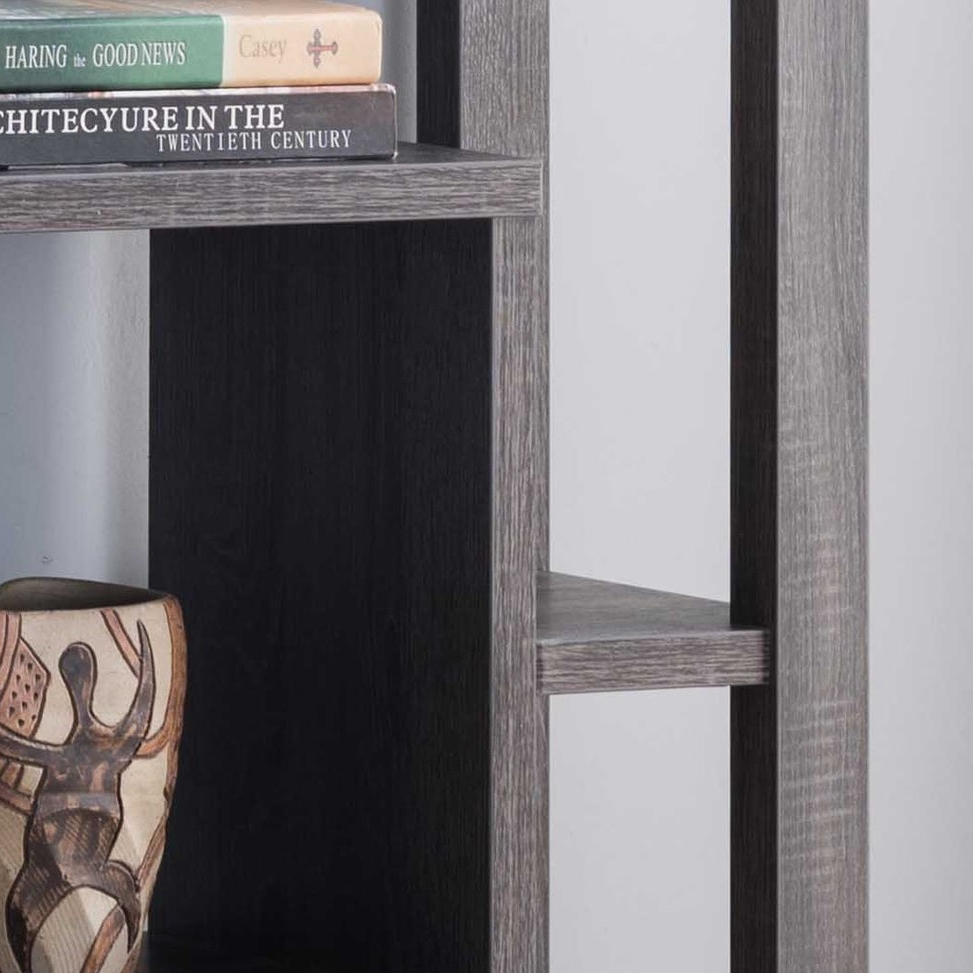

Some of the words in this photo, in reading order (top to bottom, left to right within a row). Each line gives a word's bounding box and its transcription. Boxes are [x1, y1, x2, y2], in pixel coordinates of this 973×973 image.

[73, 53, 86, 67] the
[92, 43, 138, 67] GOOD
[141, 42, 186, 66] NEWS
[239, 34, 287, 60] Casey
[184, 106, 218, 130] IN
[223, 104, 285, 129] THE
[156, 133, 262, 152] TWENTIETH
[270, 129, 352, 149] CENTURY
